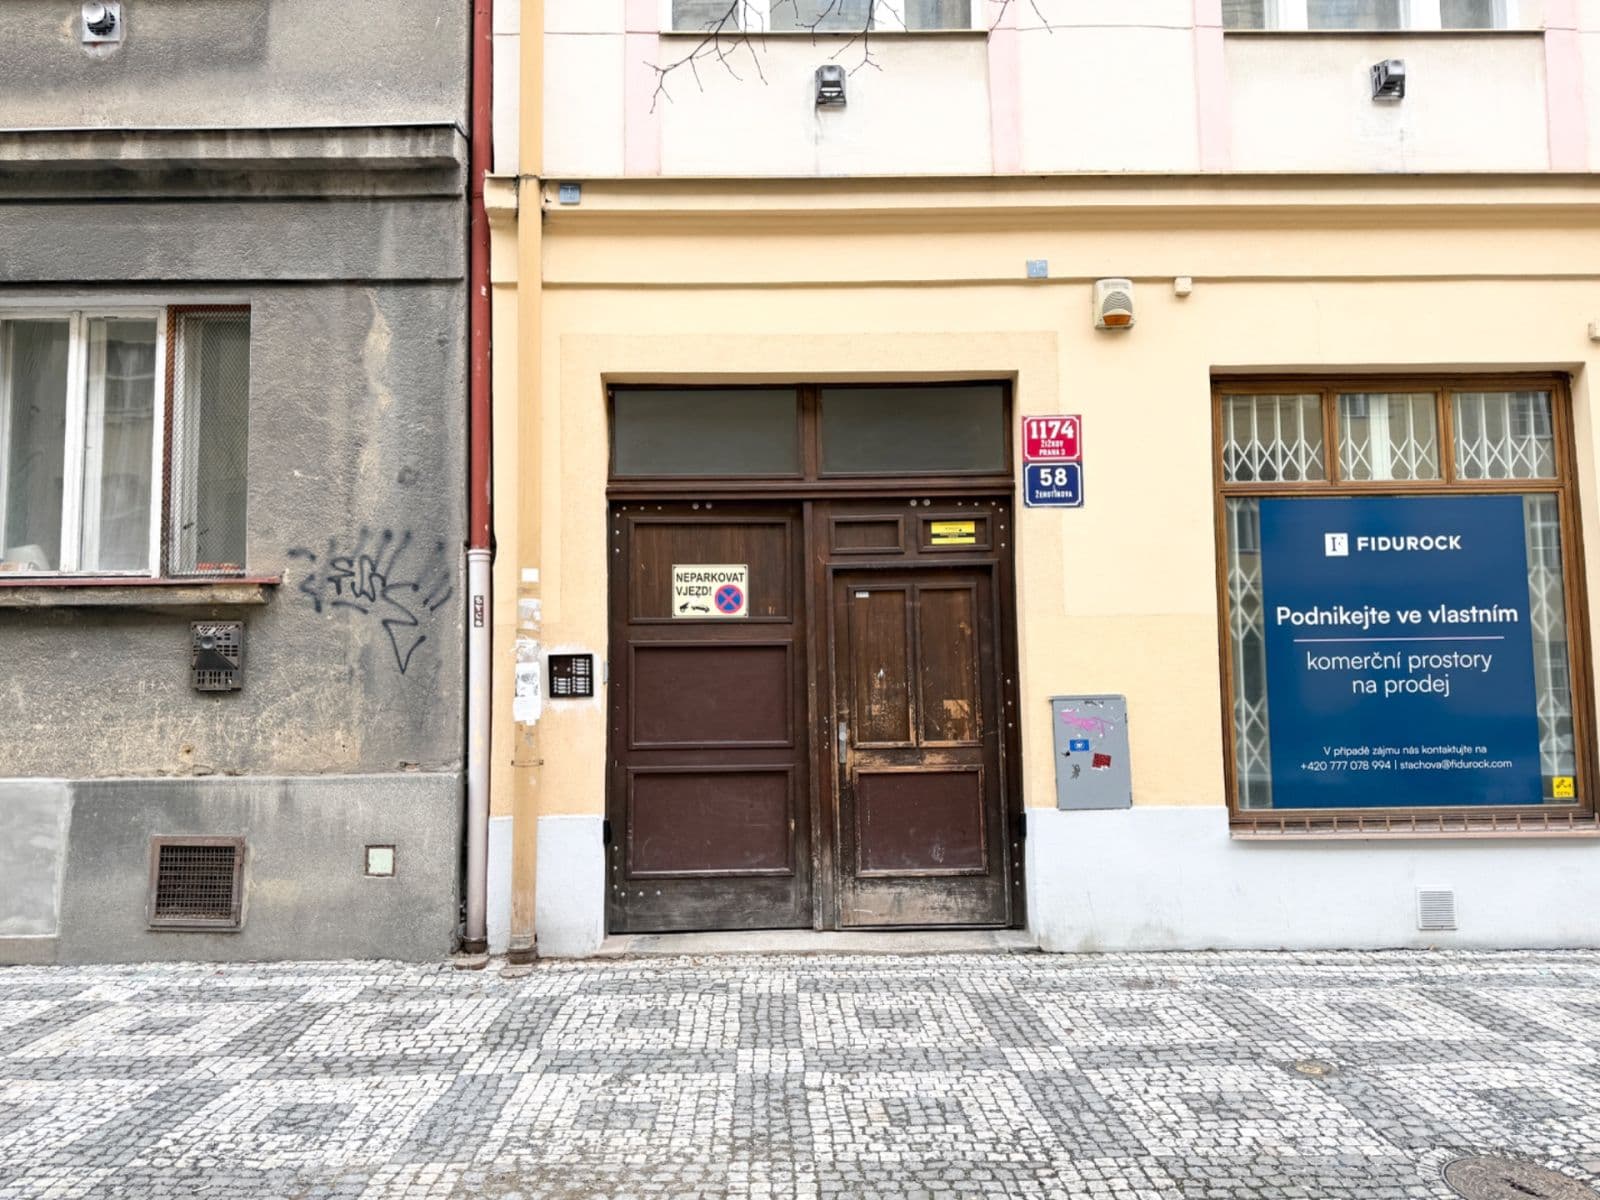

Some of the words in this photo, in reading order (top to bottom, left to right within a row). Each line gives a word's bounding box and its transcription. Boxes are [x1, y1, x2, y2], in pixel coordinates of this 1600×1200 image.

[1031, 421, 1074, 439] 1174
[1040, 468, 1067, 486] 58
[1357, 535, 1462, 551] FIDUROCK
[676, 572, 745, 583] NEPARKOVAT
[676, 586, 712, 596] VJEZD!
[1276, 605, 1391, 630] Podnikejte
[1397, 609, 1422, 624] ve
[1428, 604, 1519, 624] vlastním
[1306, 650, 1401, 671] komerční
[1408, 650, 1492, 673] prostory
[1352, 679, 1377, 694] na
[1384, 673, 1450, 698] prodej
[1323, 746, 1331, 756] V
[1333, 745, 1370, 757] případě
[1372, 745, 1400, 757] zájmu
[1402, 745, 1420, 755] nás
[1421, 744, 1473, 756] kontaktujte
[1475, 746, 1488, 754] na
[1300, 760, 1328, 771] +420
[1329, 761, 1348, 770] 777
[1350, 760, 1370, 771] 078
[1371, 760, 1391, 770] 994
[1400, 759, 1512, 770] stachova@fidurock.com
